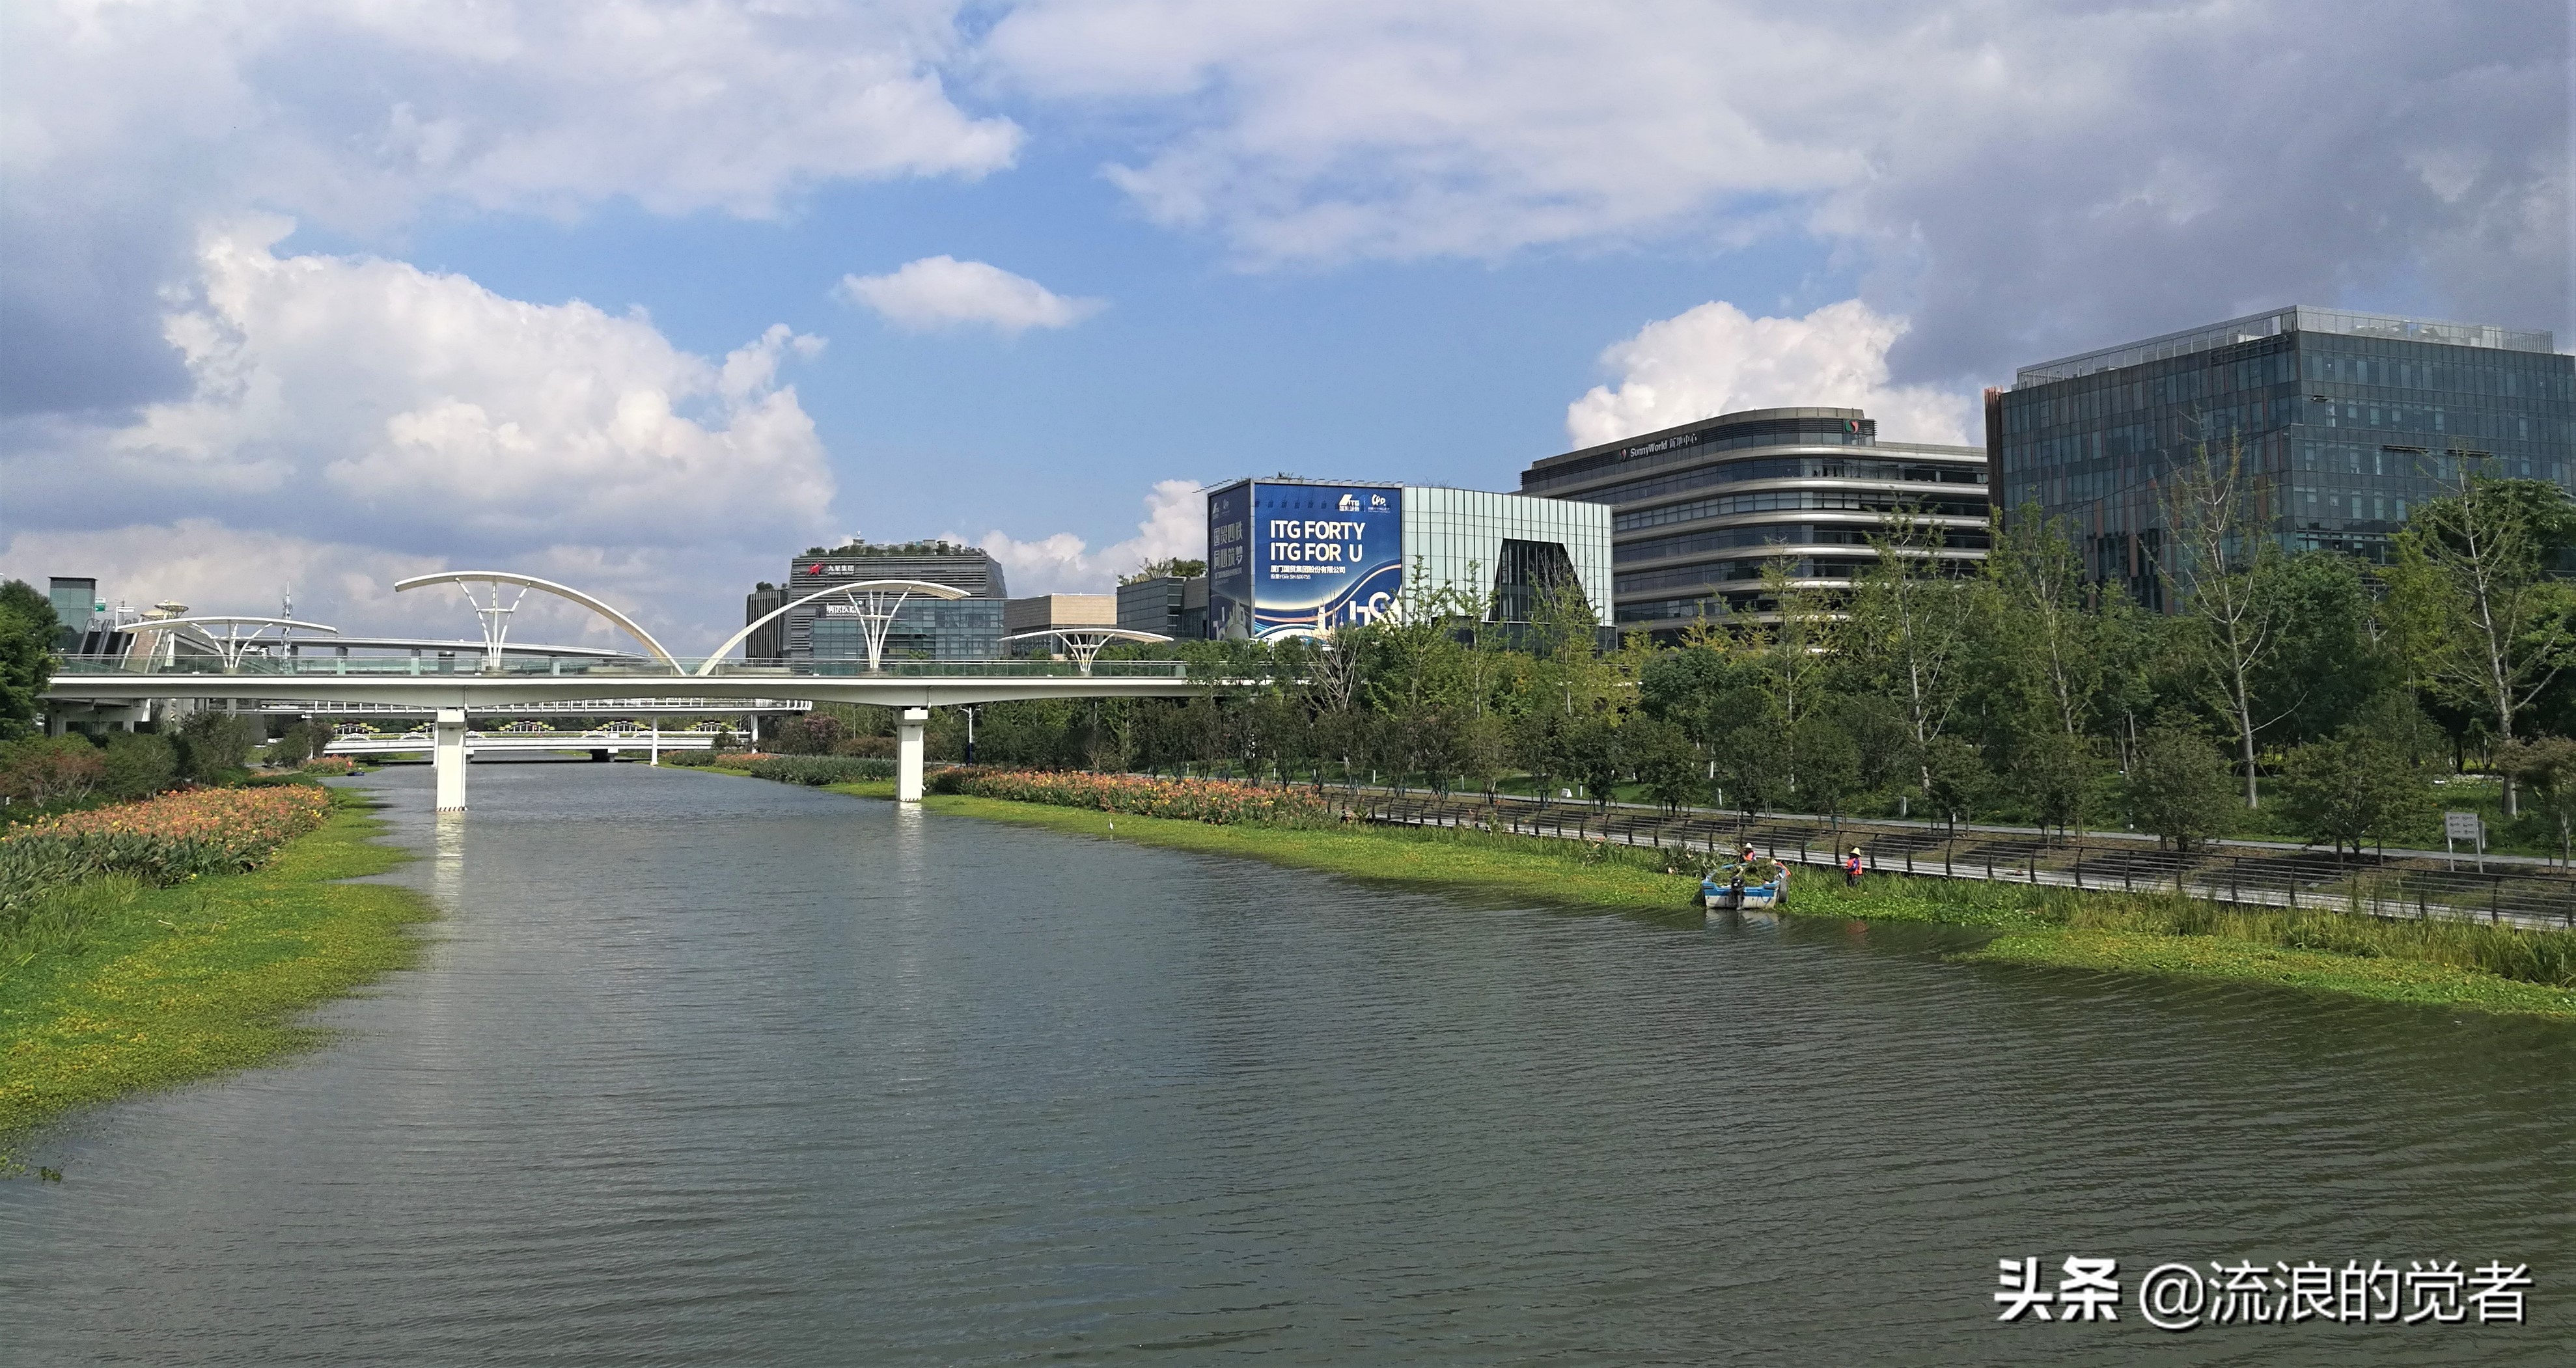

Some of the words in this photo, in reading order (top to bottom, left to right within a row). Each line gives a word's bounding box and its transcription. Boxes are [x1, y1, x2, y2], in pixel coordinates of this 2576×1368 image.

[1630, 441, 1667, 457] SunnyWorld
[1271, 520, 1301, 539] ITG
[1305, 521, 1366, 540] FORTY
[1271, 542, 1301, 561] ITG
[1305, 543, 1342, 562] FOR
[1349, 544, 1363, 562] U
[1270, 565, 1346, 574] 厦门国贸集团股份有限公司
